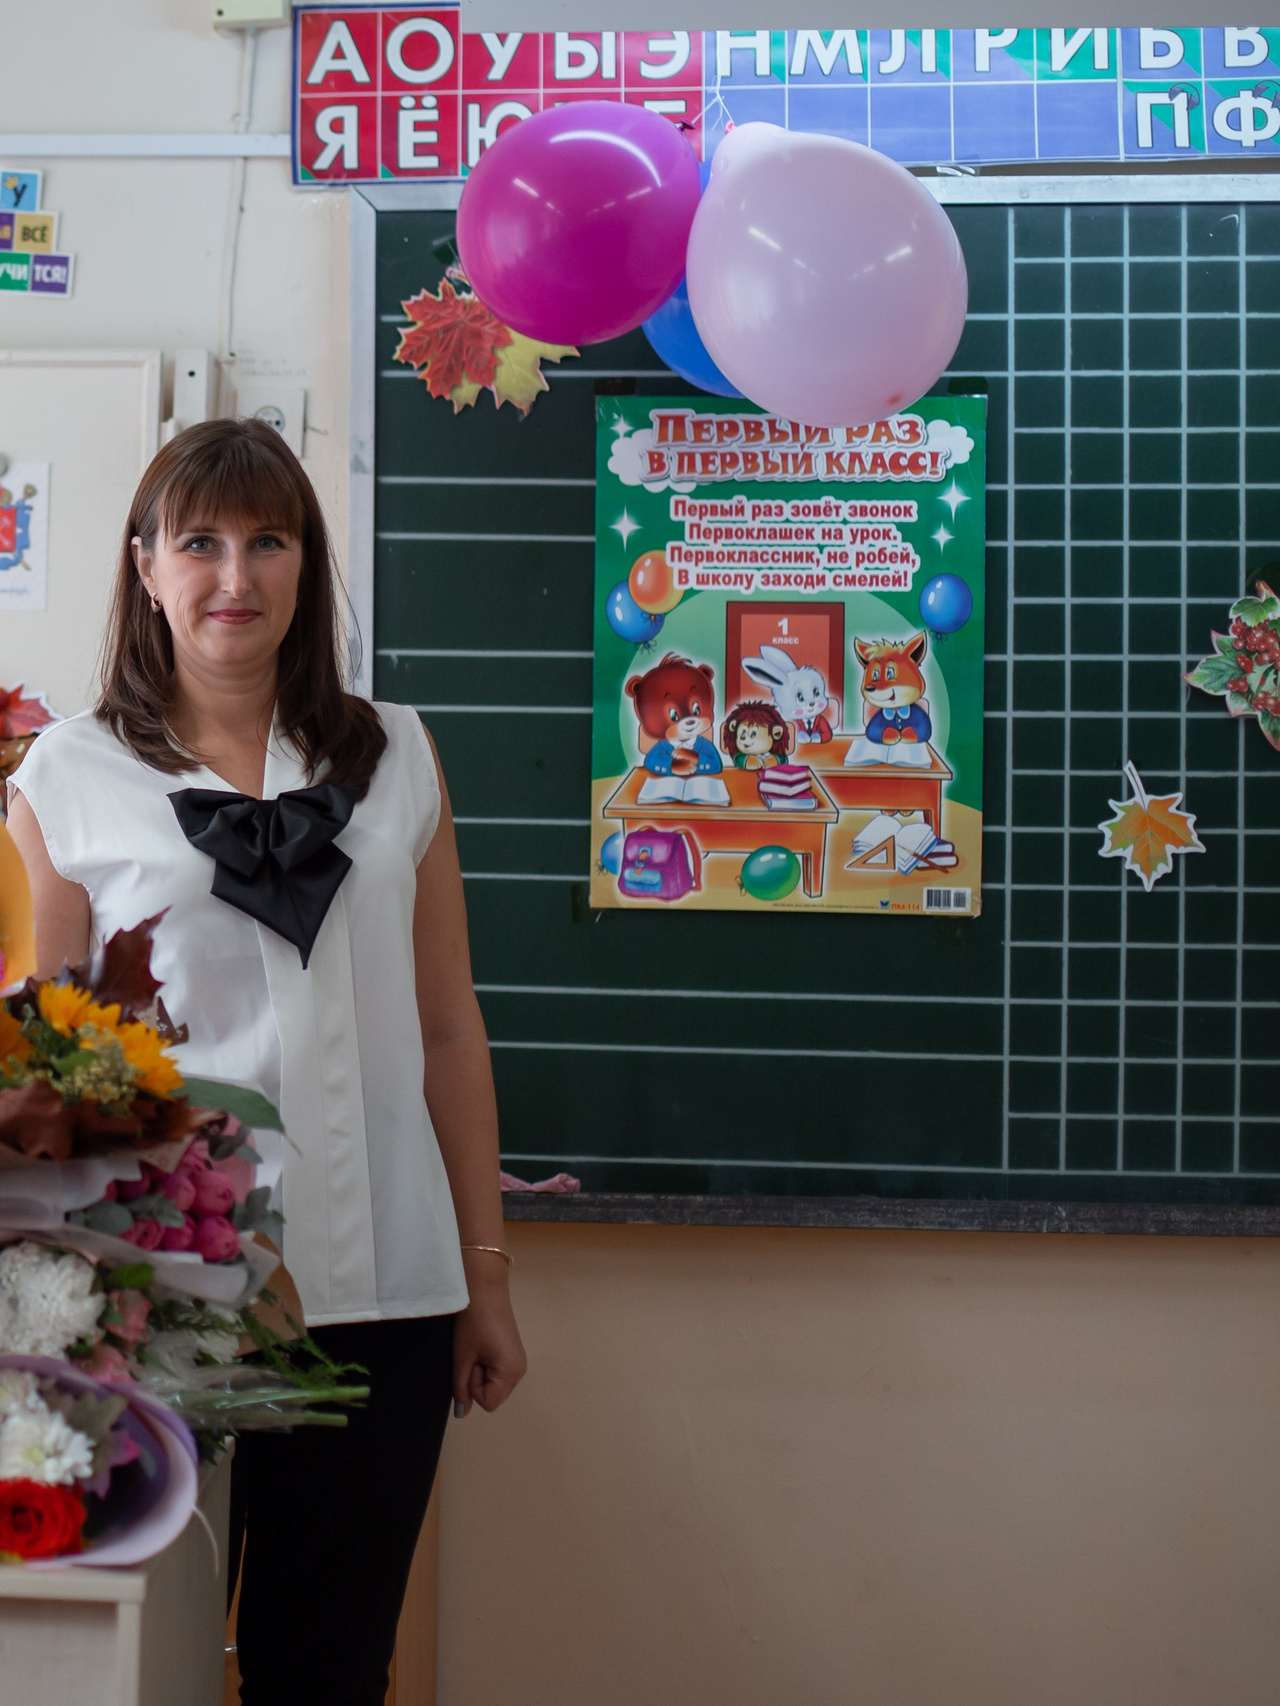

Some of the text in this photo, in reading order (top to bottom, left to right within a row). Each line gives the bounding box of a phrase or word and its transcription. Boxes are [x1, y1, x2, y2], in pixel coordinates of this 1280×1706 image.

[306, 19, 372, 85] А
[384, 17, 456, 84] О
[718, 30, 772, 78] Н
[312, 103, 359, 170] Я
[397, 94, 441, 169] Ё
[646, 446, 940, 476] В ПЕРВЫЙ КЛАСС!
[674, 499, 913, 521] Первый раз зовёт звонок
[689, 523, 898, 545] Первоклашек на урок.
[670, 546, 916, 568] Первоклассник, не робей,
[678, 569, 908, 590] В школу заходи смелей!
[777, 617, 788, 636] 1
[772, 637, 799, 645] класс
